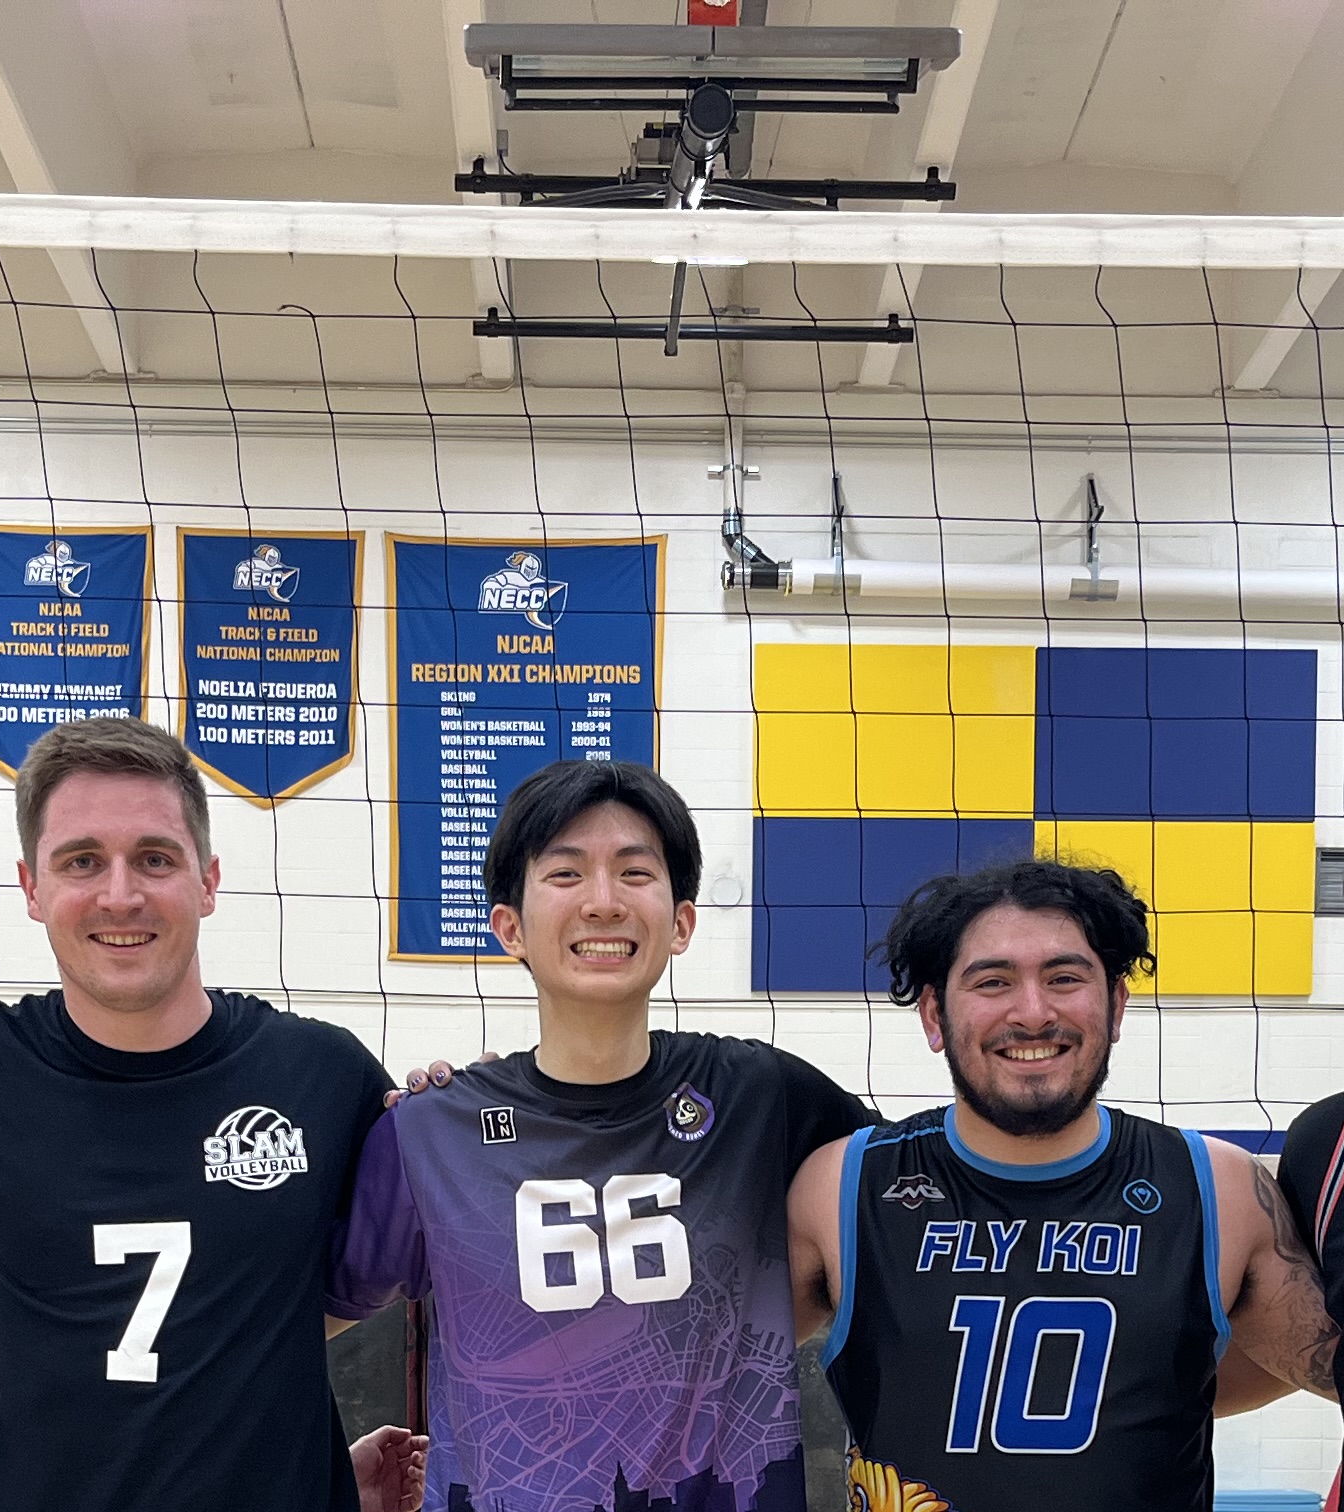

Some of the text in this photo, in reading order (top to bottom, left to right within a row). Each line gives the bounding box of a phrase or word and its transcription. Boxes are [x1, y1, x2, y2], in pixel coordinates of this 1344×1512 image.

[28, 567, 74, 582] NECC
[237, 572, 282, 587] NECC
[483, 588, 545, 609] NECC
[39, 602, 82, 617] NJCAA
[11, 622, 55, 636] TRACK
[71, 624, 109, 638] FIELD
[219, 626, 318, 643] TRACK & FIELD
[57, 643, 130, 658] CHAMPION
[497, 635, 555, 654] NJCAA
[266, 647, 340, 663] CHAMPION
[411, 663, 641, 684] REGION XXI CHAMPIONS
[54, 684, 122, 701] MWANGI
[198, 679, 337, 699] NOELIA FIGUEROA
[440, 691, 476, 702] SKIING
[21, 707, 86, 723] METERS
[196, 703, 338, 723] 200 METERS 2010
[440, 721, 486, 732] WOMEN'S
[487, 721, 546, 732] BASKETBALL
[198, 725, 336, 746] 100 METERS 2011
[440, 735, 486, 746] WOMEN'S
[487, 735, 546, 746] BASKETBALL
[440, 749, 497, 760] VOLLEYBALL
[441, 764, 488, 775] BASEBALL
[441, 778, 497, 789] VOLLEYBALL
[441, 793, 497, 803] VOLLEYBALL
[441, 807, 497, 818] VOLLEYBALL
[441, 821, 488, 832] BASEBALL
[441, 865, 483, 875] BASEBAL
[441, 908, 487, 918] BASEBALL
[441, 922, 493, 933] VOLLEYBAL
[440, 936, 487, 947] BASEBALL
[203, 1127, 306, 1165] SLAM
[208, 1158, 306, 1179] VOLLEYBALL
[515, 1172, 692, 1313] 66
[916, 1219, 1141, 1276] FLY KOI
[92, 1221, 192, 1382] 7
[945, 1295, 1117, 1454] 10
